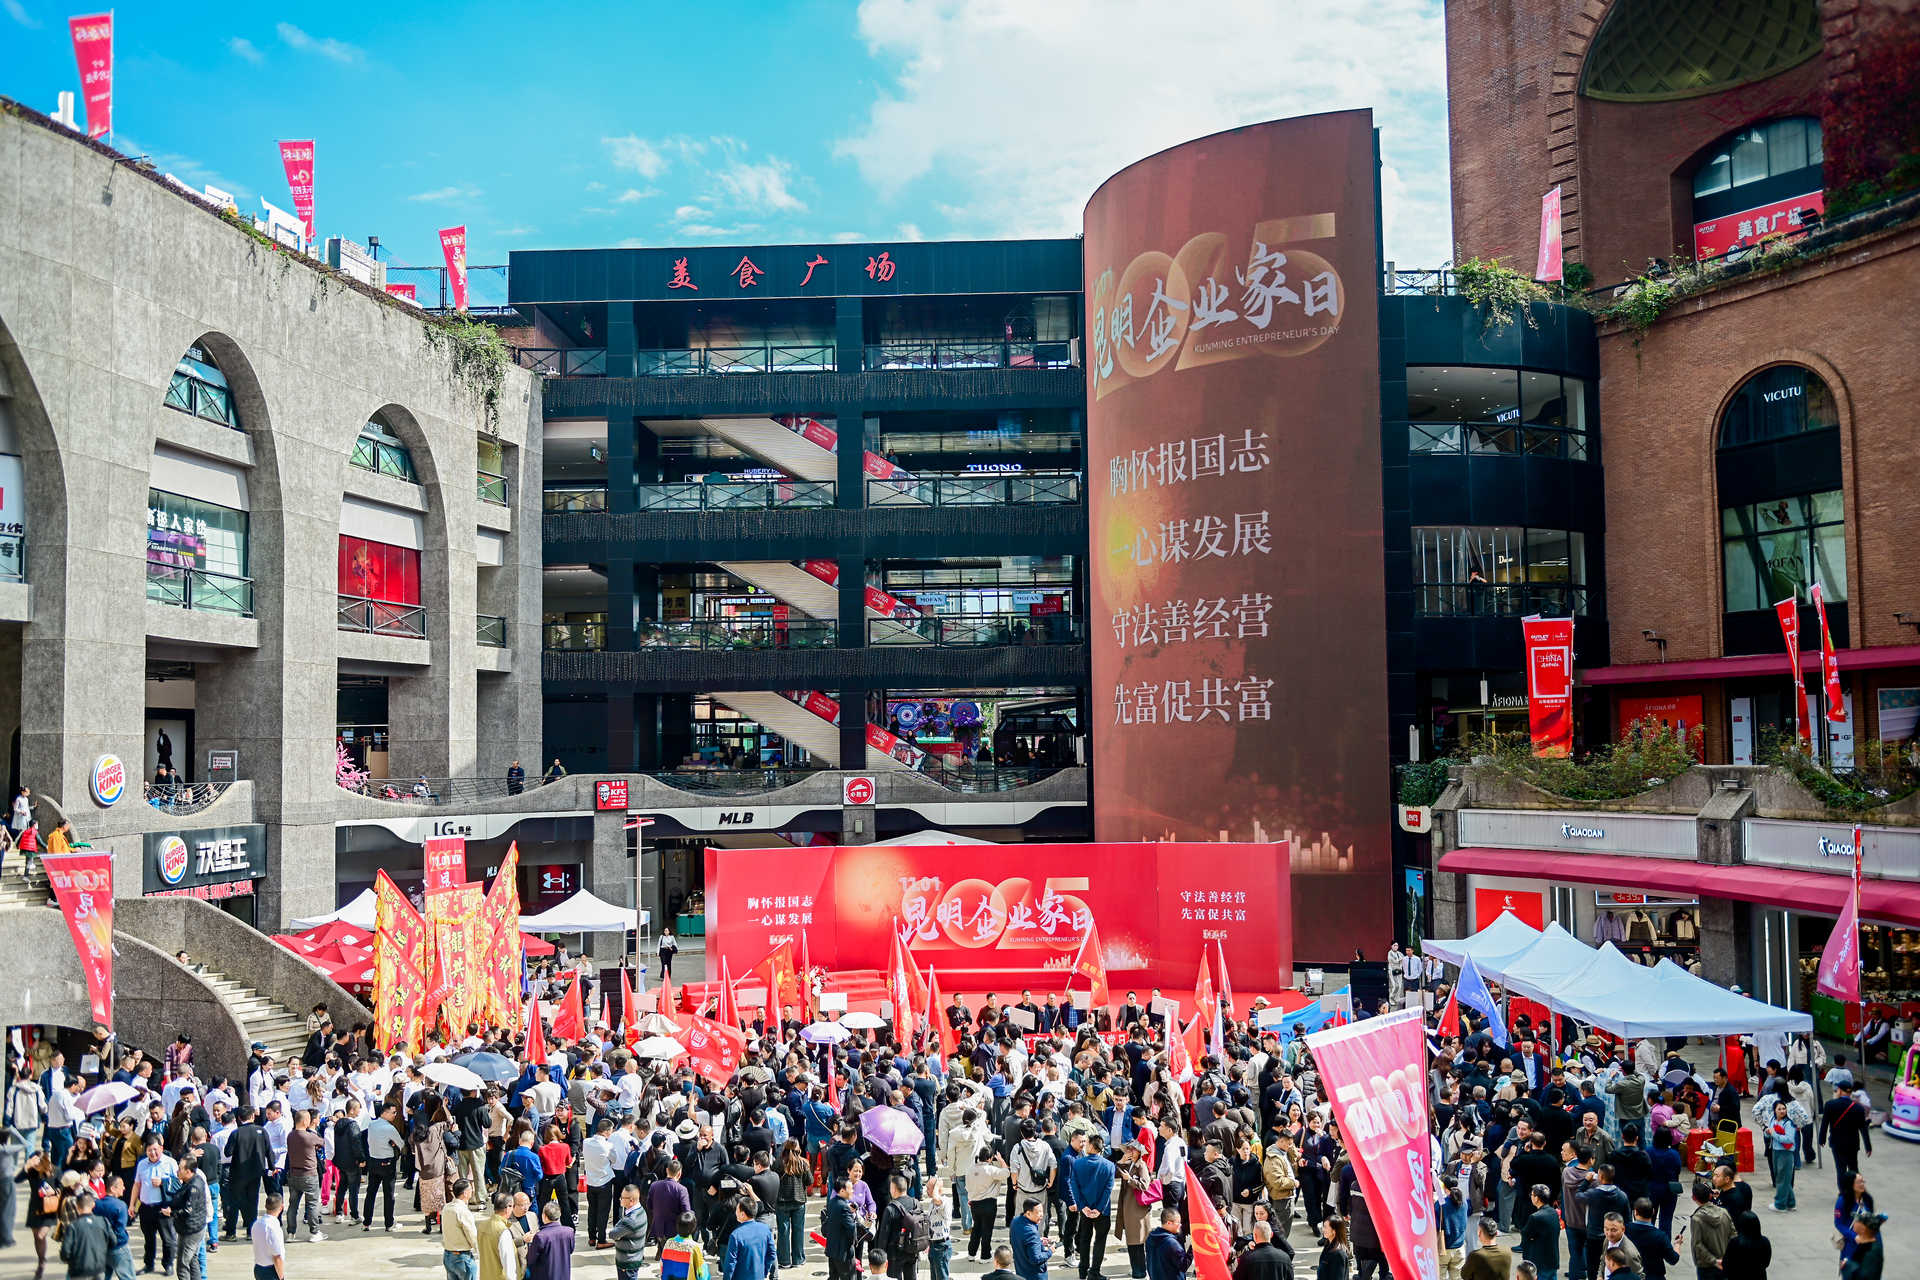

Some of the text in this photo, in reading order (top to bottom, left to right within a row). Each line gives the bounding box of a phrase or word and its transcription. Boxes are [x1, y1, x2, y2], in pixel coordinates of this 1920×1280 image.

[667, 251, 897, 291] 美食广场
[1093, 241, 1338, 389] 昆明企业家日
[1194, 338, 1235, 353] KUNMING
[1319, 326, 1340, 336] DAY
[1763, 384, 1802, 402] VICUTU
[966, 463, 1022, 472] TUONO
[1110, 429, 1271, 497] 胸怀报国志
[1111, 510, 1273, 567] 一心谋发展
[1112, 592, 1273, 649] 守法善经营
[1112, 675, 1275, 728] 先富促共富
[97, 761, 122, 782] BURGER
[98, 772, 123, 794] KING
[719, 812, 754, 824] MLB
[1571, 827, 1604, 838] QIAODAN
[164, 845, 185, 862] BURGER
[166, 853, 185, 875] KING
[195, 838, 250, 875] 汉堡王
[210, 883, 233, 900] SINCE
[1180, 890, 1247, 903] 守法善经营
[747, 895, 814, 910] 胸怀报国志
[747, 912, 813, 926] 一心谋发展
[899, 888, 1093, 943] 昆明企业家日
[1180, 907, 1247, 921] 先富促共富
